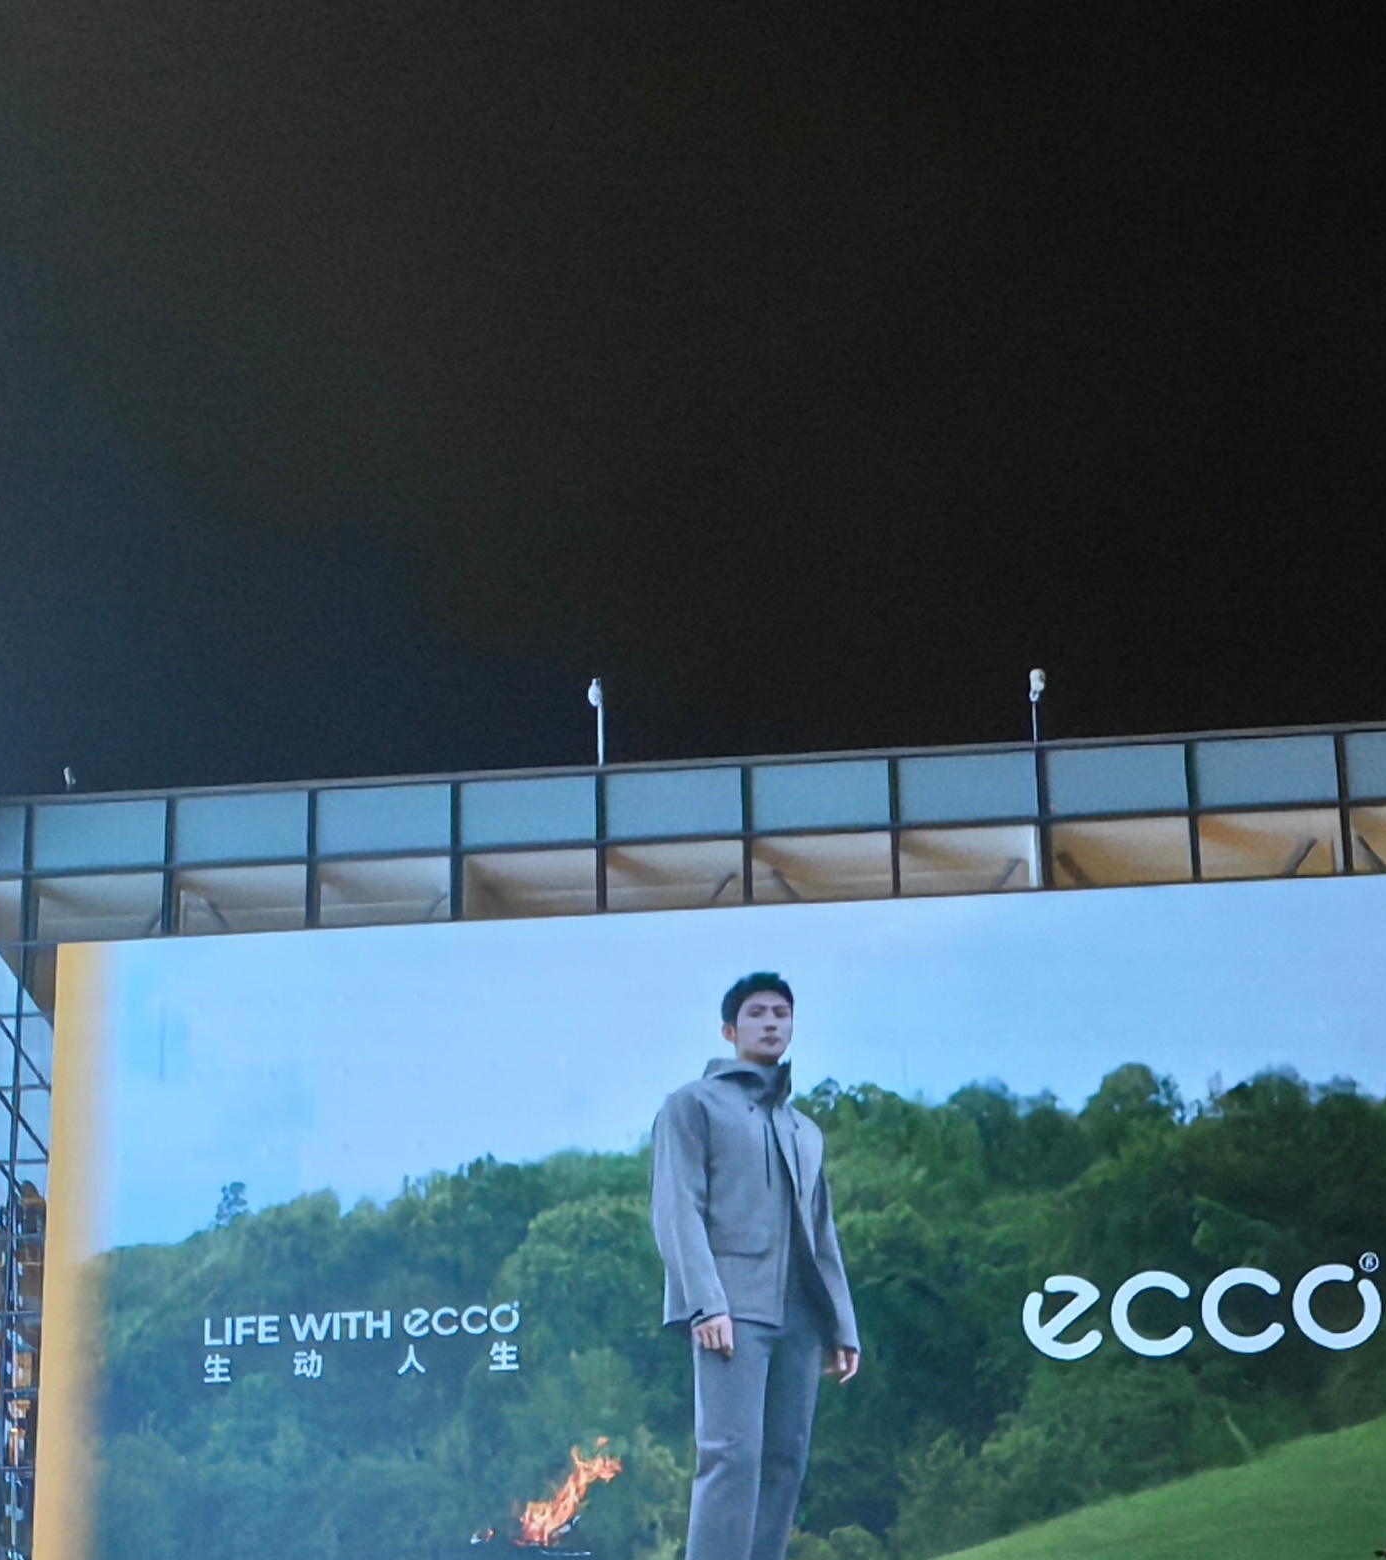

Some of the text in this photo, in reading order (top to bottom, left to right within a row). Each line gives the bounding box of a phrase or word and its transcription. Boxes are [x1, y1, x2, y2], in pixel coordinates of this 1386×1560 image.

[203, 1302, 520, 1345] LIFE WITH ecco
[1022, 1263, 1382, 1361] ecco
